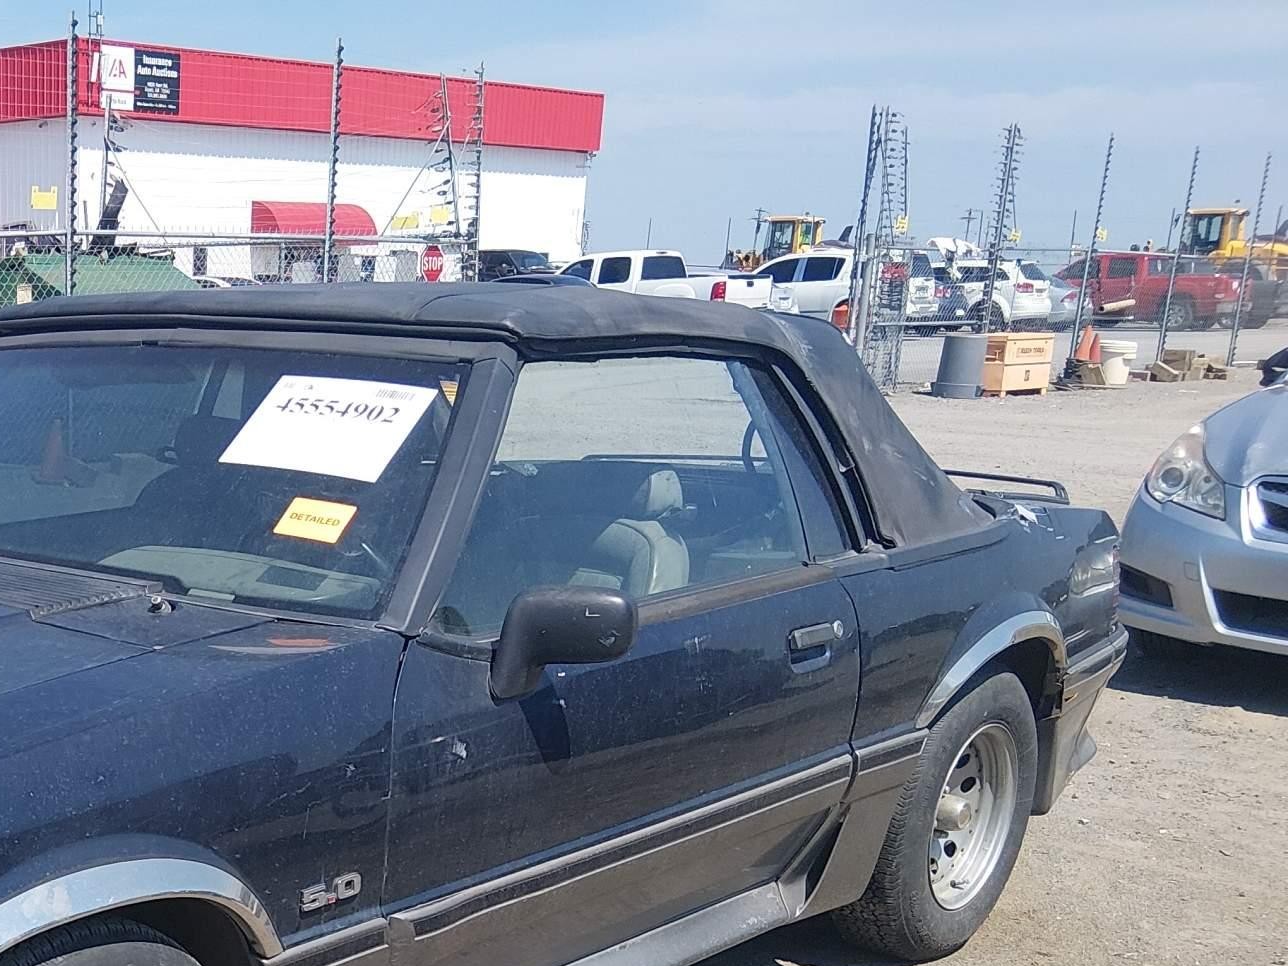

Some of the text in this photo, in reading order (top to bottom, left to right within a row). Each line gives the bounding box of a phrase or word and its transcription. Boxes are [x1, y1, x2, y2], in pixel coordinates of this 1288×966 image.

[136, 64, 152, 76] Auto
[423, 256, 443, 271] STOP
[276, 397, 401, 424] 45554902
[288, 511, 341, 527] DETAILED
[298, 872, 362, 913] 5.0
